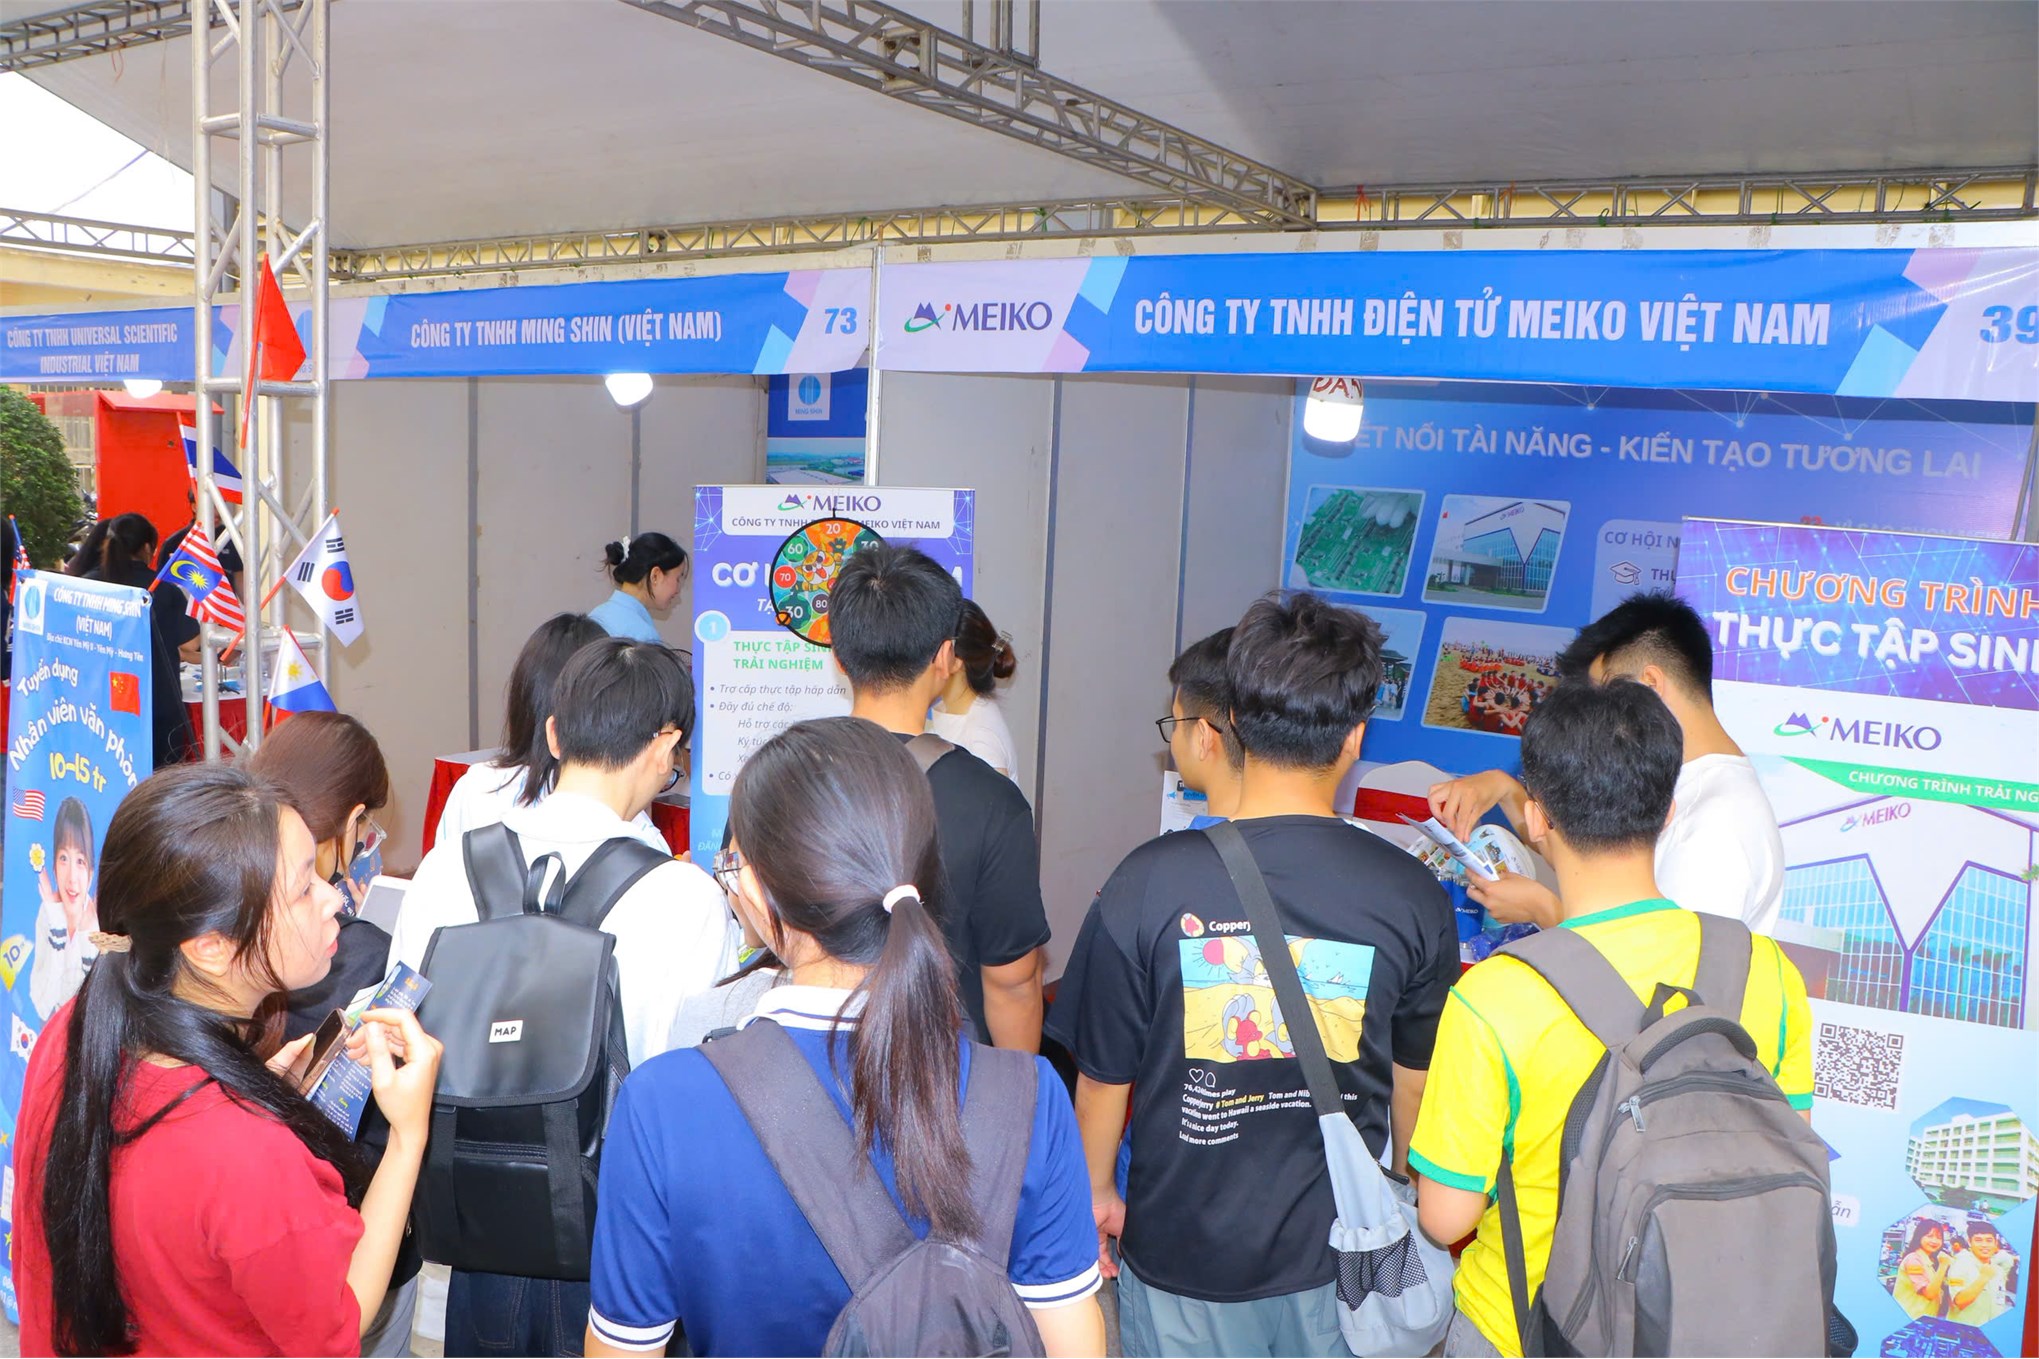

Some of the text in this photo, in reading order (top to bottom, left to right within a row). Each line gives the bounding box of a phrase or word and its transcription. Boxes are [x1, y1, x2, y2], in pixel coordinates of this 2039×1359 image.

[410, 308, 722, 348] CÔNG TY TNHH MING SHIN (VIỆT NAM)
[824, 307, 857, 335] 73
[952, 301, 1053, 332] MEIKO
[1134, 286, 1831, 351] CÔNG TY TNHH ĐIỆN TỬ MEIKO VIỆT NAM
[1980, 305, 2039, 344] 39
[7, 323, 178, 348] CÔNG TY TNHH UNIVERSAL SCIENTIFIC
[40, 351, 140, 377] INDUSTRIAL VIỆT NAM
[1395, 421, 1444, 451] NỐI
[1452, 423, 1496, 453] TÀI
[1505, 425, 1592, 458] NĂNG
[1619, 431, 1694, 464] KIẾN
[1702, 439, 1771, 472] TẠO
[1781, 443, 1912, 475] TƯƠNG
[1922, 450, 1982, 480] LAI
[813, 495, 882, 512] MEIKO
[732, 517, 761, 527] CÔNG
[764, 519, 776, 527] TY
[891, 519, 913, 532] VIỆT
[915, 521, 940, 530] NAM
[825, 523, 841, 535] 20
[787, 542, 803, 555] 60
[1604, 531, 1627, 545] CƠ
[1632, 531, 1662, 549] HỘI
[711, 561, 758, 588] CƠ
[780, 571, 791, 582] 70
[54, 586, 74, 606] CÔNG
[74, 591, 82, 607] TY
[1726, 567, 1907, 608] CHƯƠNG
[815, 600, 828, 609] 80
[76, 615, 112, 641] (VIỆT NAM)
[733, 641, 771, 654] THỰC
[776, 638, 801, 655] TẬP
[1712, 610, 2039, 674] THỰC TẬP SIN
[733, 657, 823, 672] TRẢI NGHIỆM
[16, 657, 79, 697] Tuyển dụng
[9, 696, 138, 789] Nhân viên văn phòn
[1830, 717, 1942, 750] MEIKO
[49, 752, 107, 793] 10-15 tr
[1849, 770, 1918, 789] CHƯƠNG
[1923, 776, 1971, 795] TRÌNH
[1975, 784, 2011, 801] TRẢI
[1862, 803, 1911, 827] MEIKO
[3, 945, 21, 969] 10
[494, 1026, 517, 1036] MAP
[1202, 1112, 1221, 1121] went
[1221, 1111, 1228, 1119] to
[1228, 1105, 1250, 1117] Hawaii
[1255, 1102, 1280, 1112] seaside
[1280, 1100, 1312, 1109] vacation.
[1221, 1099, 1235, 1108] Tom
[1235, 1095, 1247, 1104] and
[1248, 1094, 1265, 1103] Jerry
[1268, 1091, 1284, 1100] Tom
[1284, 1090, 1297, 1098] and
[1189, 1137, 1207, 1146] more
[1207, 1132, 1239, 1146] comments
[1205, 1124, 1219, 1134] day
